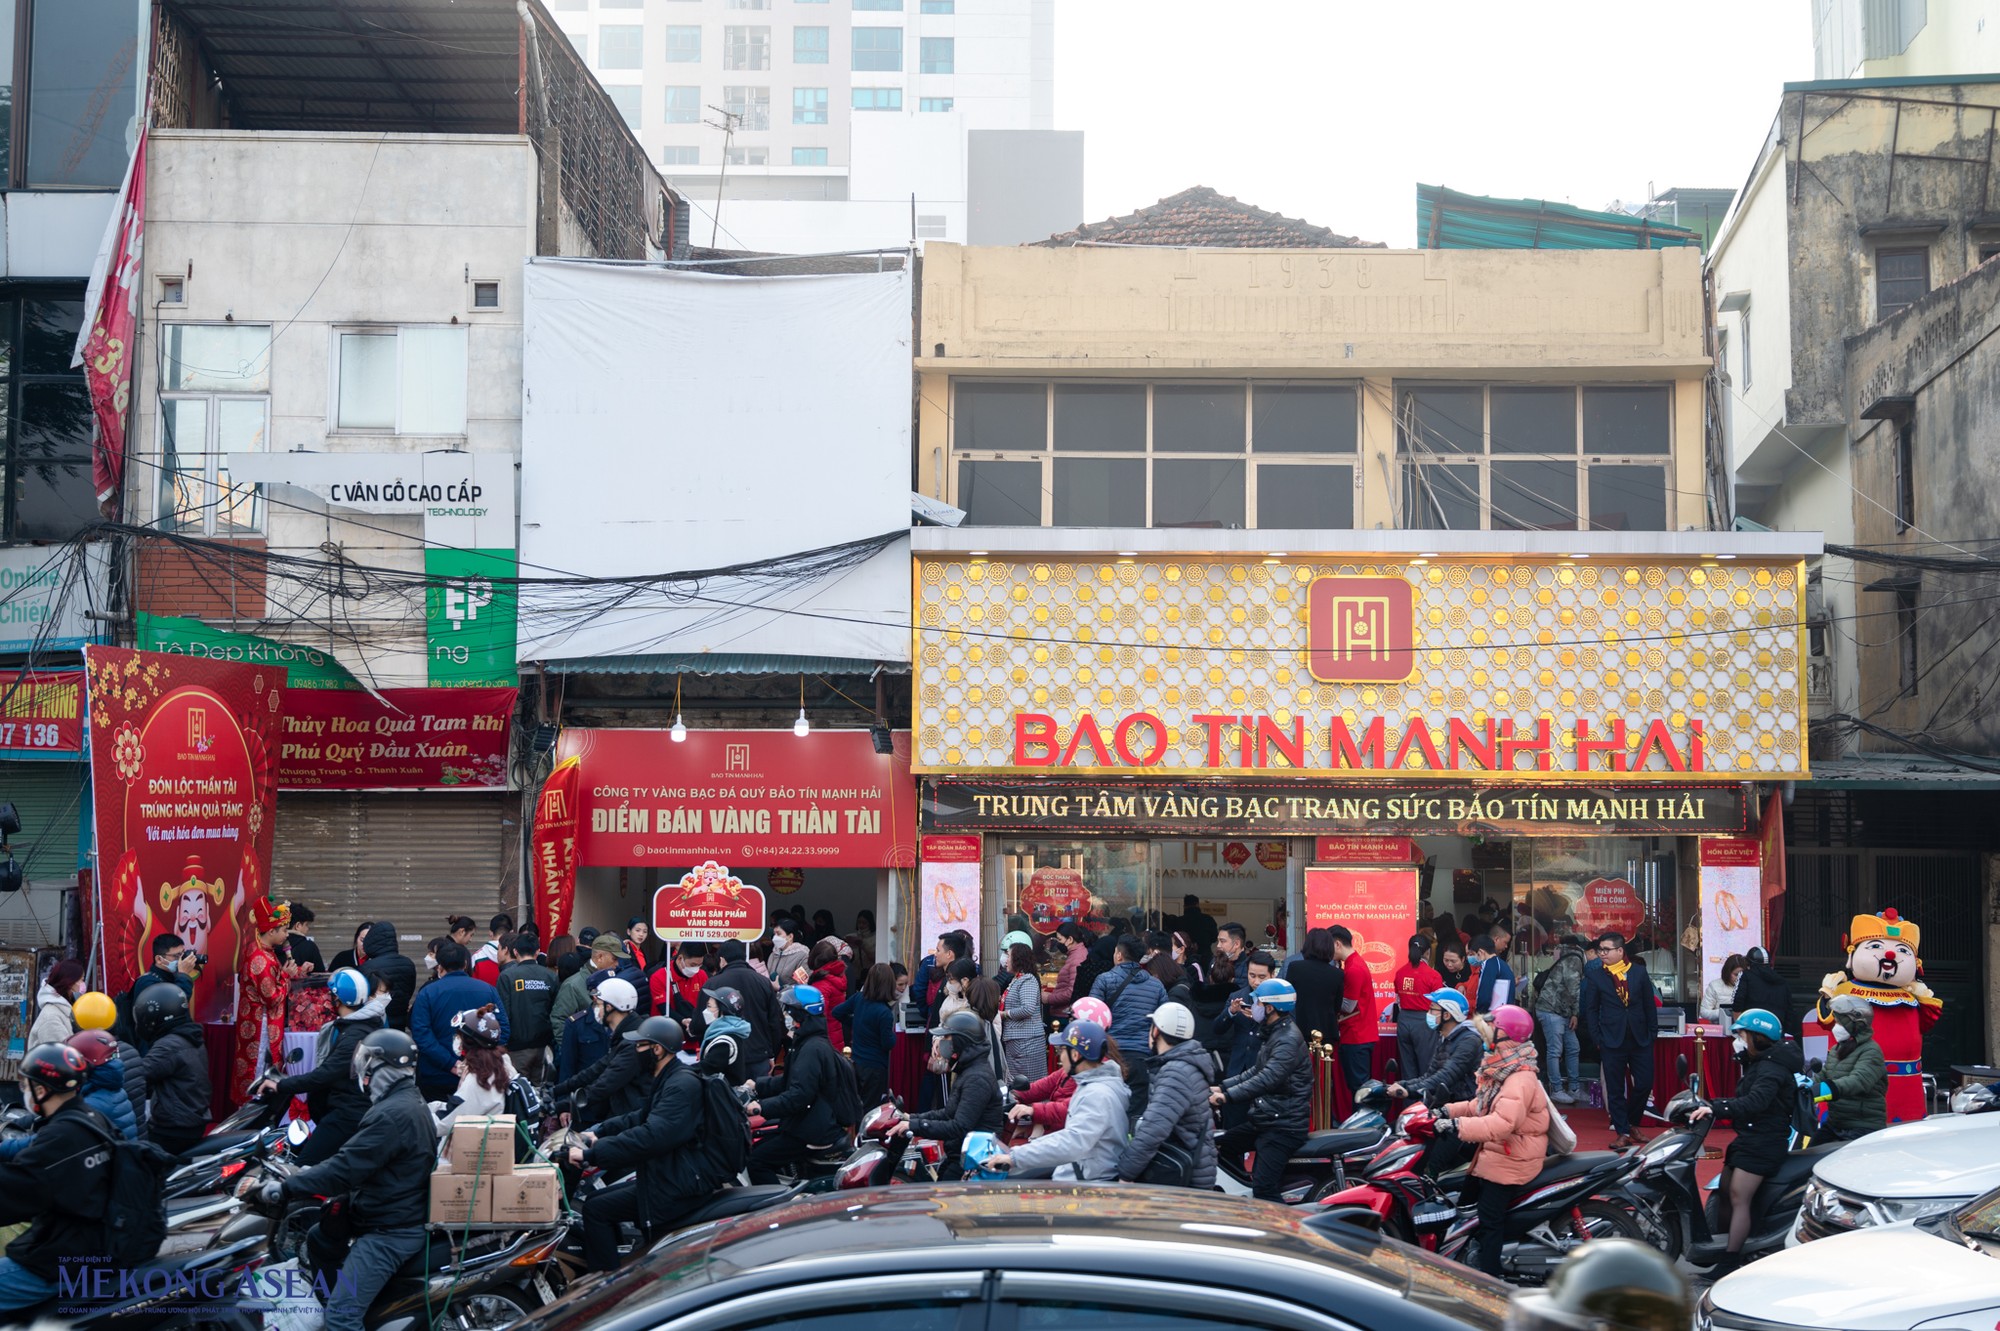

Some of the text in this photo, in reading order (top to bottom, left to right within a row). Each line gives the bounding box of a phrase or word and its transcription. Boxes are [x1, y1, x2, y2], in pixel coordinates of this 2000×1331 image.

[1247, 256, 1373, 289] 1938
[344, 481, 378, 501] VÂN
[408, 484, 442, 501] CAO
[447, 478, 482, 502] CẤP
[427, 507, 488, 516] TECHNOLOGY
[0, 565, 59, 589] Online
[248, 642, 325, 667] Không
[22, 723, 59, 746] 136
[331, 716, 370, 733] Hoa
[375, 714, 415, 736] Quả
[421, 715, 466, 732] Tam
[281, 739, 468, 763] Phú Quý Đầu Xuân
[279, 767, 316, 776] Khương
[318, 767, 346, 776] Trung
[399, 766, 423, 774] Xuân
[148, 775, 237, 798] ĐÓN LỘC THẦN TÀI
[593, 785, 881, 801] CÔNG TY VÀNG BẠC ĐÁ QUÝ BẢO TÍN MẠNH HẢI
[140, 800, 243, 820] TRÚNG NGÀN QUÀ TẶNG
[591, 800, 881, 835] ĐIỂM BÁN VÀNG THẦN TÀI
[973, 790, 1705, 825] TRUNG TÂM VÀNG BẠC TRANG SỨC BẢO TÍN MẠNH HẢI
[146, 824, 239, 843] Với mọi hóa đơn mua hàng
[647, 846, 840, 856] baotinmanhhai.vn (+84) 24.22.33.9999
[1328, 841, 1398, 851] BẢO TÍN MẠNH HẢI
[687, 918, 730, 927] VÀNG 999.9
[691, 908, 706, 918] BÁN
[708, 908, 723, 918] SẢN
[725, 907, 747, 918] PHẨM
